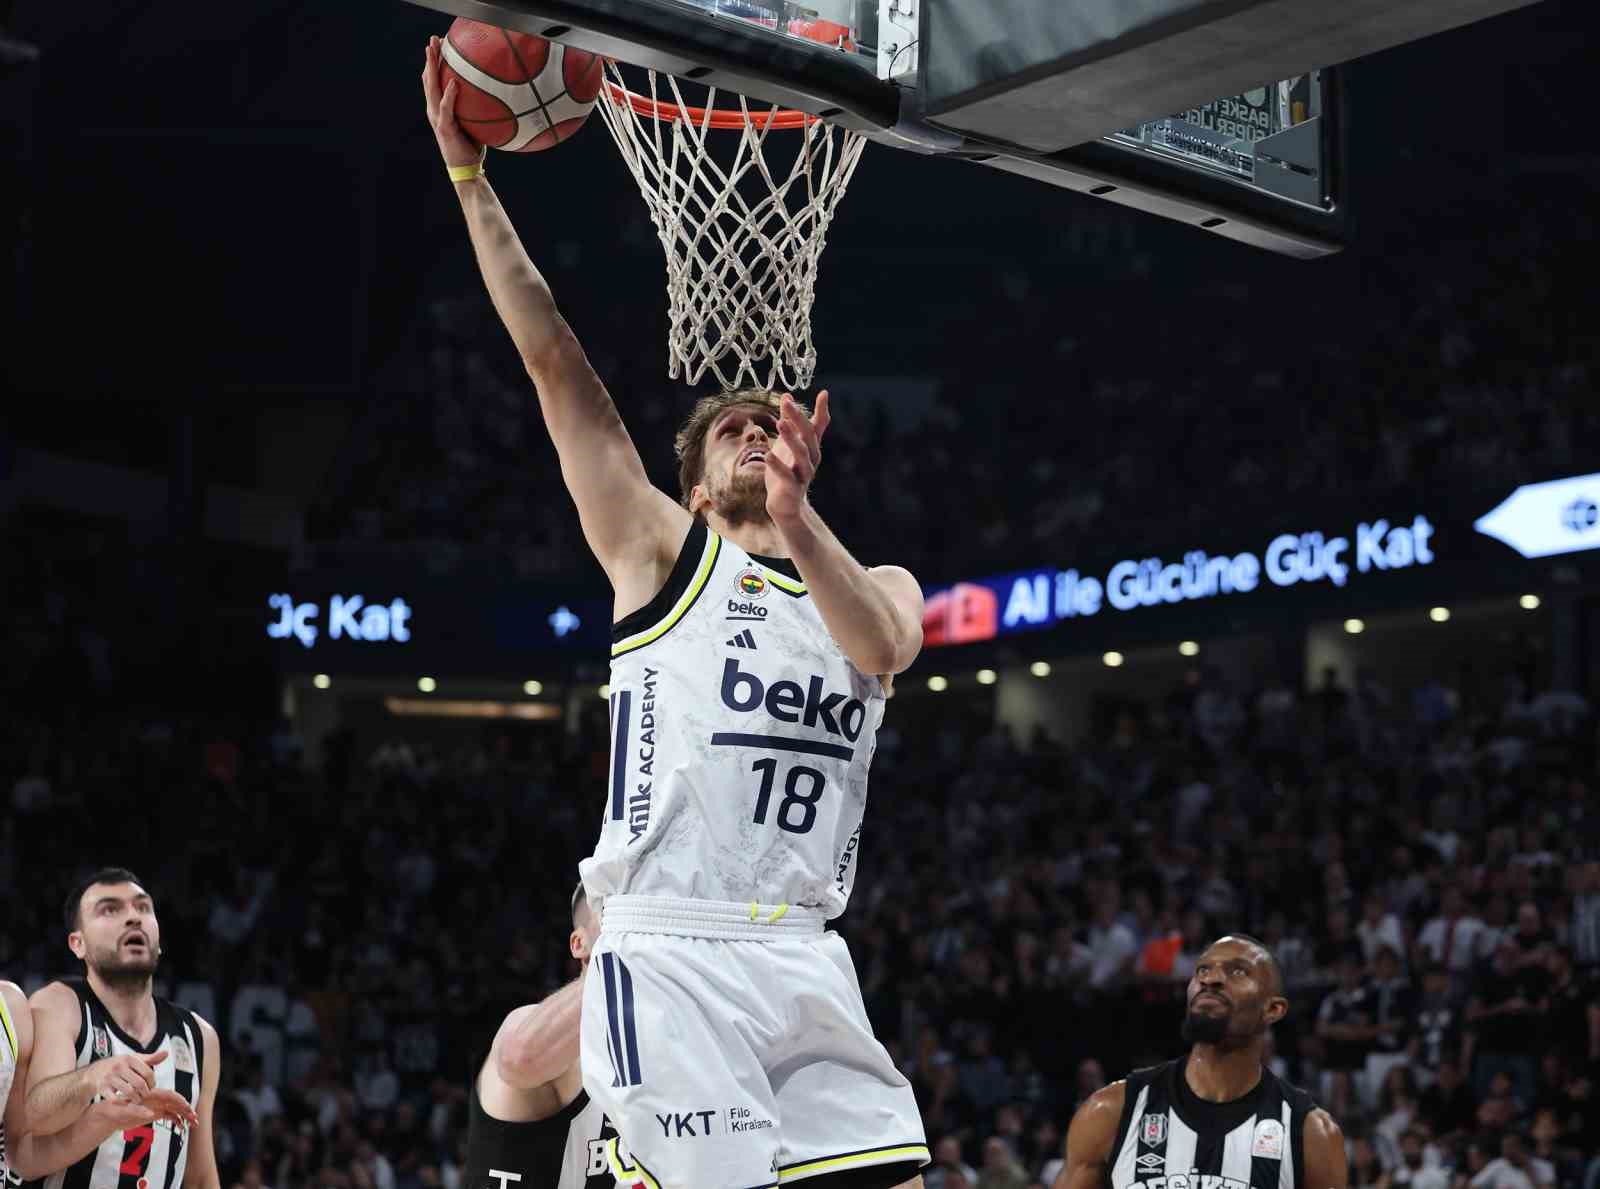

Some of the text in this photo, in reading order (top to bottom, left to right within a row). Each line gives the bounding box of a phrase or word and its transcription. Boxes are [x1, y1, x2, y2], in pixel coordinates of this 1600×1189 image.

[1054, 568, 1102, 618] ile
[1106, 550, 1259, 611] Gücüne
[1265, 531, 1349, 587] Güç
[1356, 514, 1434, 572] Kat
[328, 593, 412, 642] Kat
[728, 600, 768, 618] beko
[639, 667, 660, 778] ACADEMY
[720, 657, 866, 743] beko
[751, 757, 826, 835] 18
[655, 1107, 751, 1138] YKT Filo
